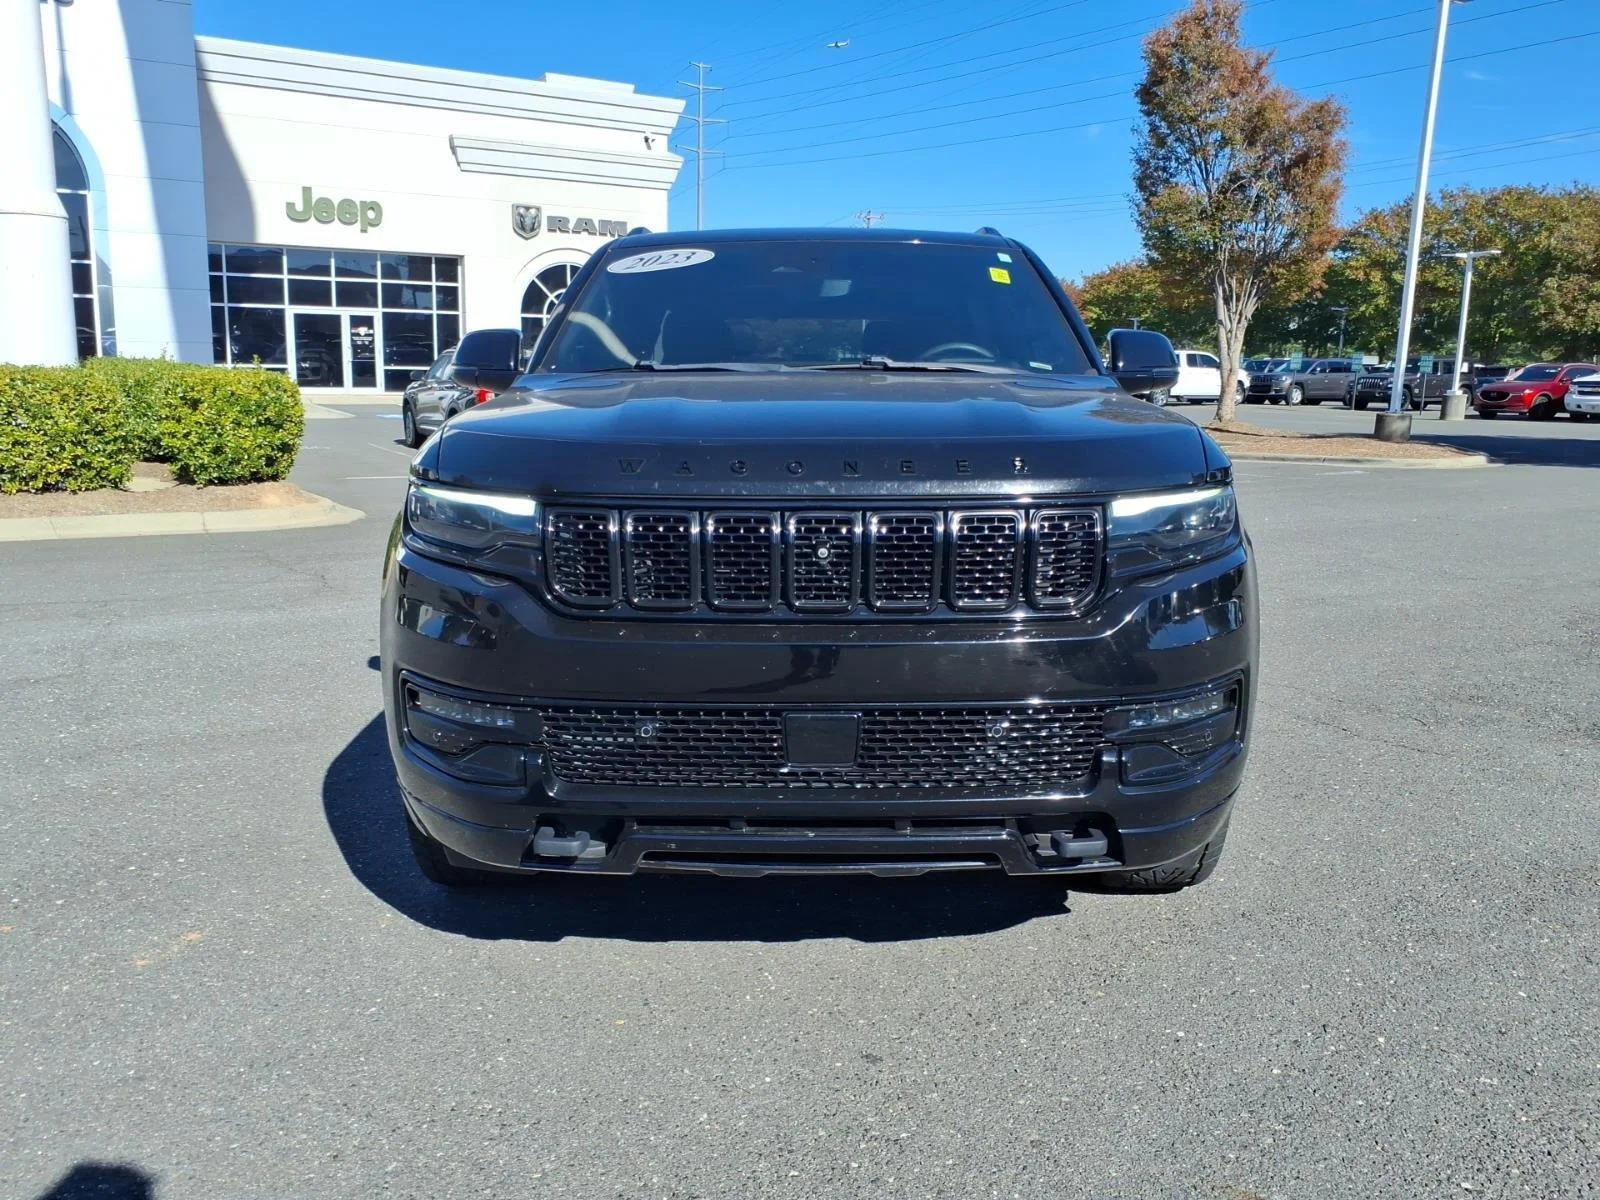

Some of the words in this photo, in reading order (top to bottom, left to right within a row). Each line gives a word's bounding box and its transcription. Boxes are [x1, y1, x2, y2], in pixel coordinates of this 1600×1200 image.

[286, 186, 383, 233] Jeep
[546, 215, 628, 238] RAM
[622, 251, 698, 271] 2023
[616, 456, 1031, 476] WAGONEER
